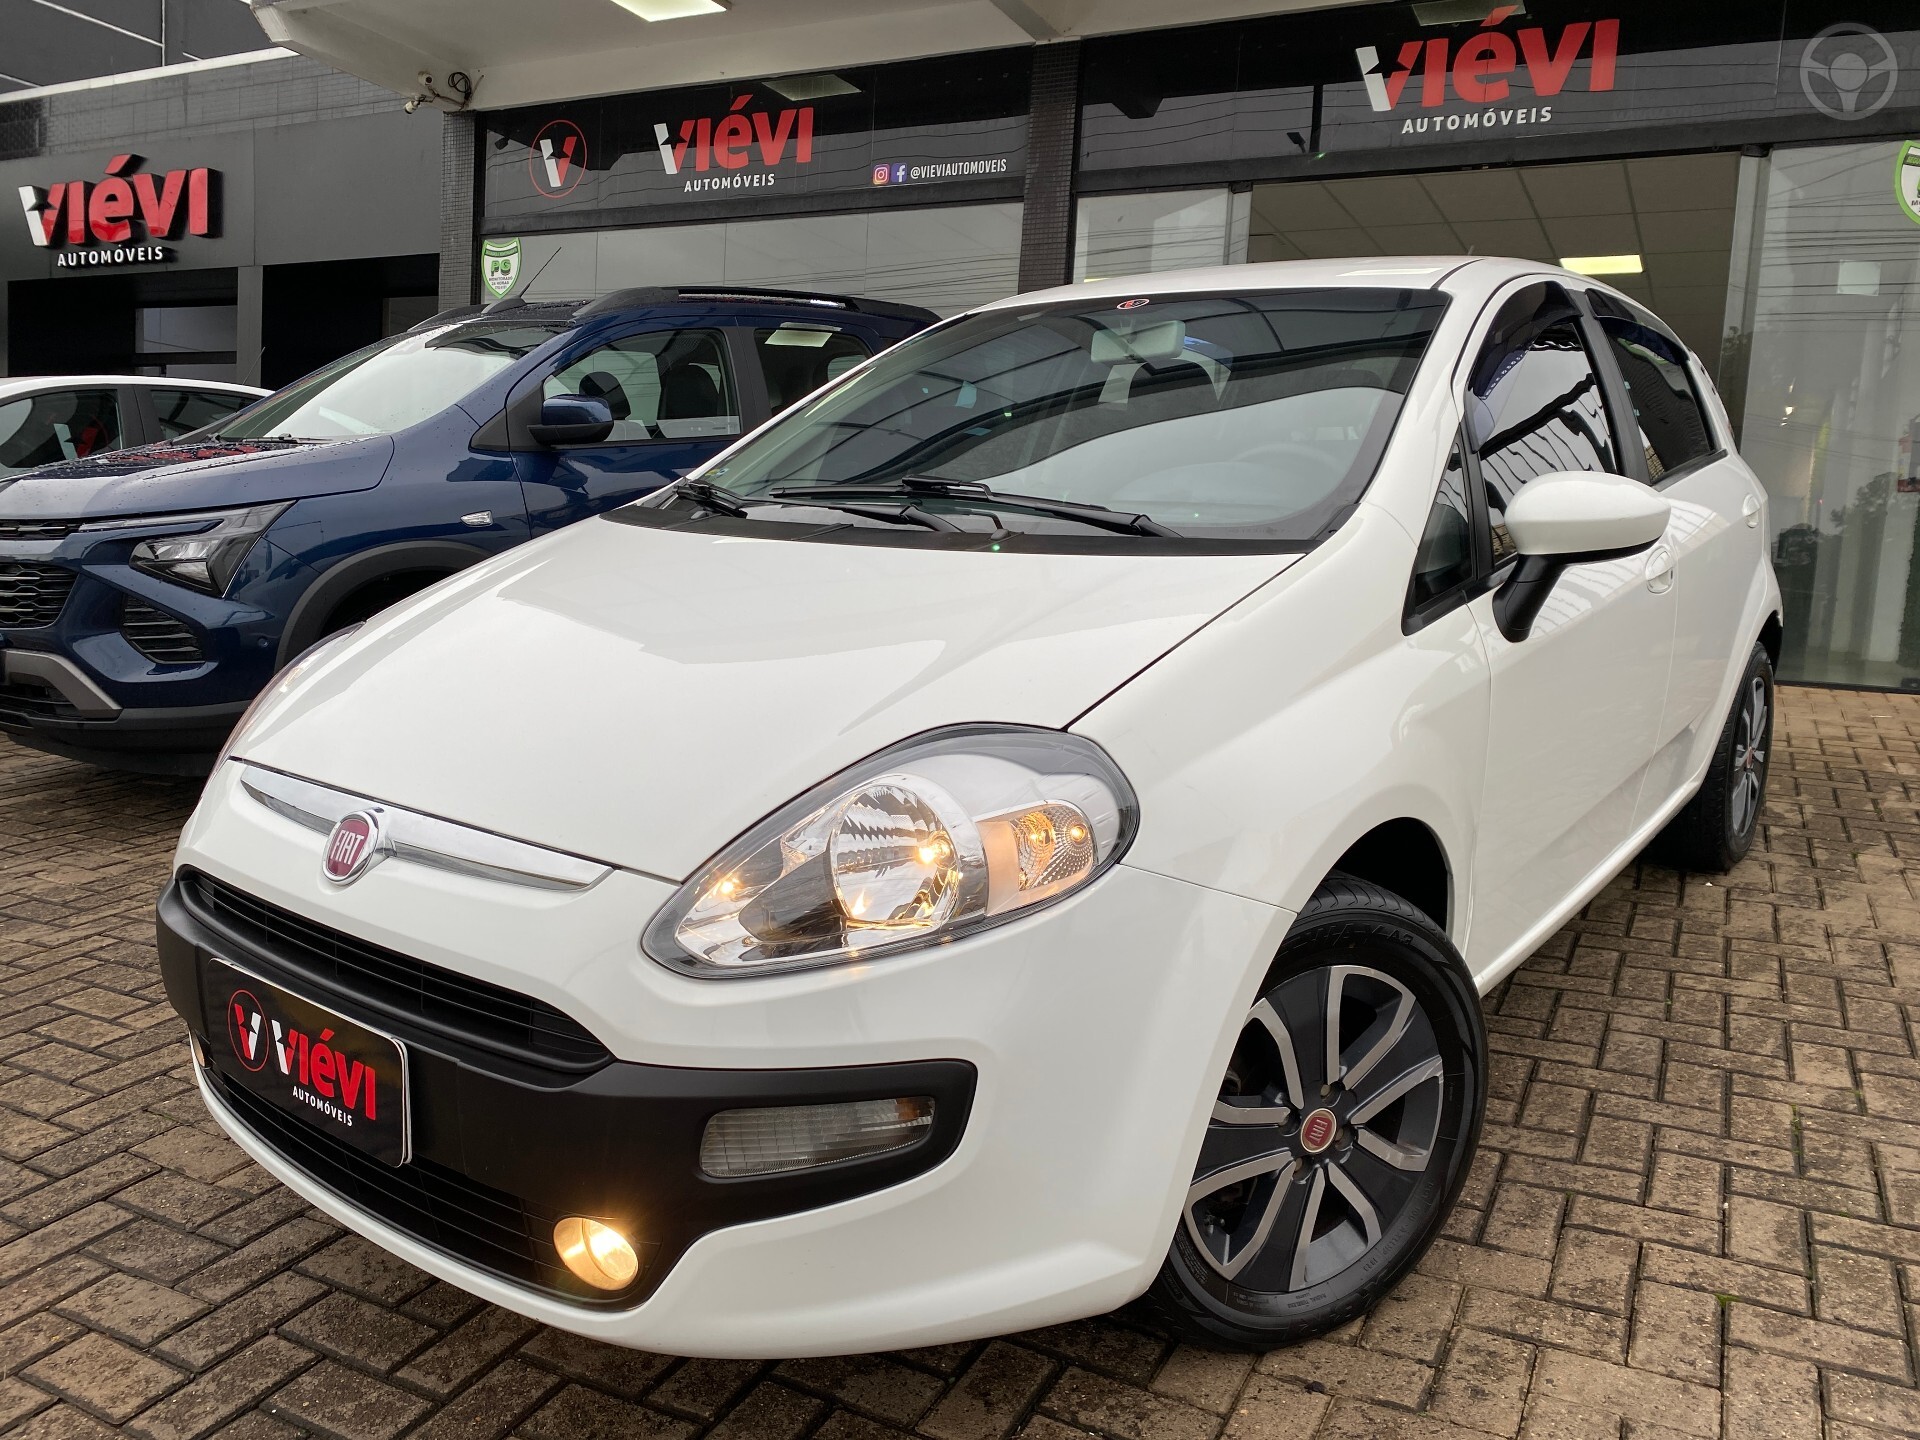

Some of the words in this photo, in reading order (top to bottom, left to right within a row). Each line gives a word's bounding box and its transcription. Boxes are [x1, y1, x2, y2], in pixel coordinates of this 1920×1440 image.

[1401, 107, 1552, 134] AUTOMÓVEIS
[910, 158, 1008, 180] @VIEVIAUTOMOVEIS
[683, 173, 776, 193] AUTOMÓVEIS
[57, 244, 163, 267] AUTOMÓVEIS
[330, 829, 365, 865] FIAT
[292, 1085, 353, 1127] AUTOMÓVEIS
[1308, 1118, 1328, 1144] FIAT
